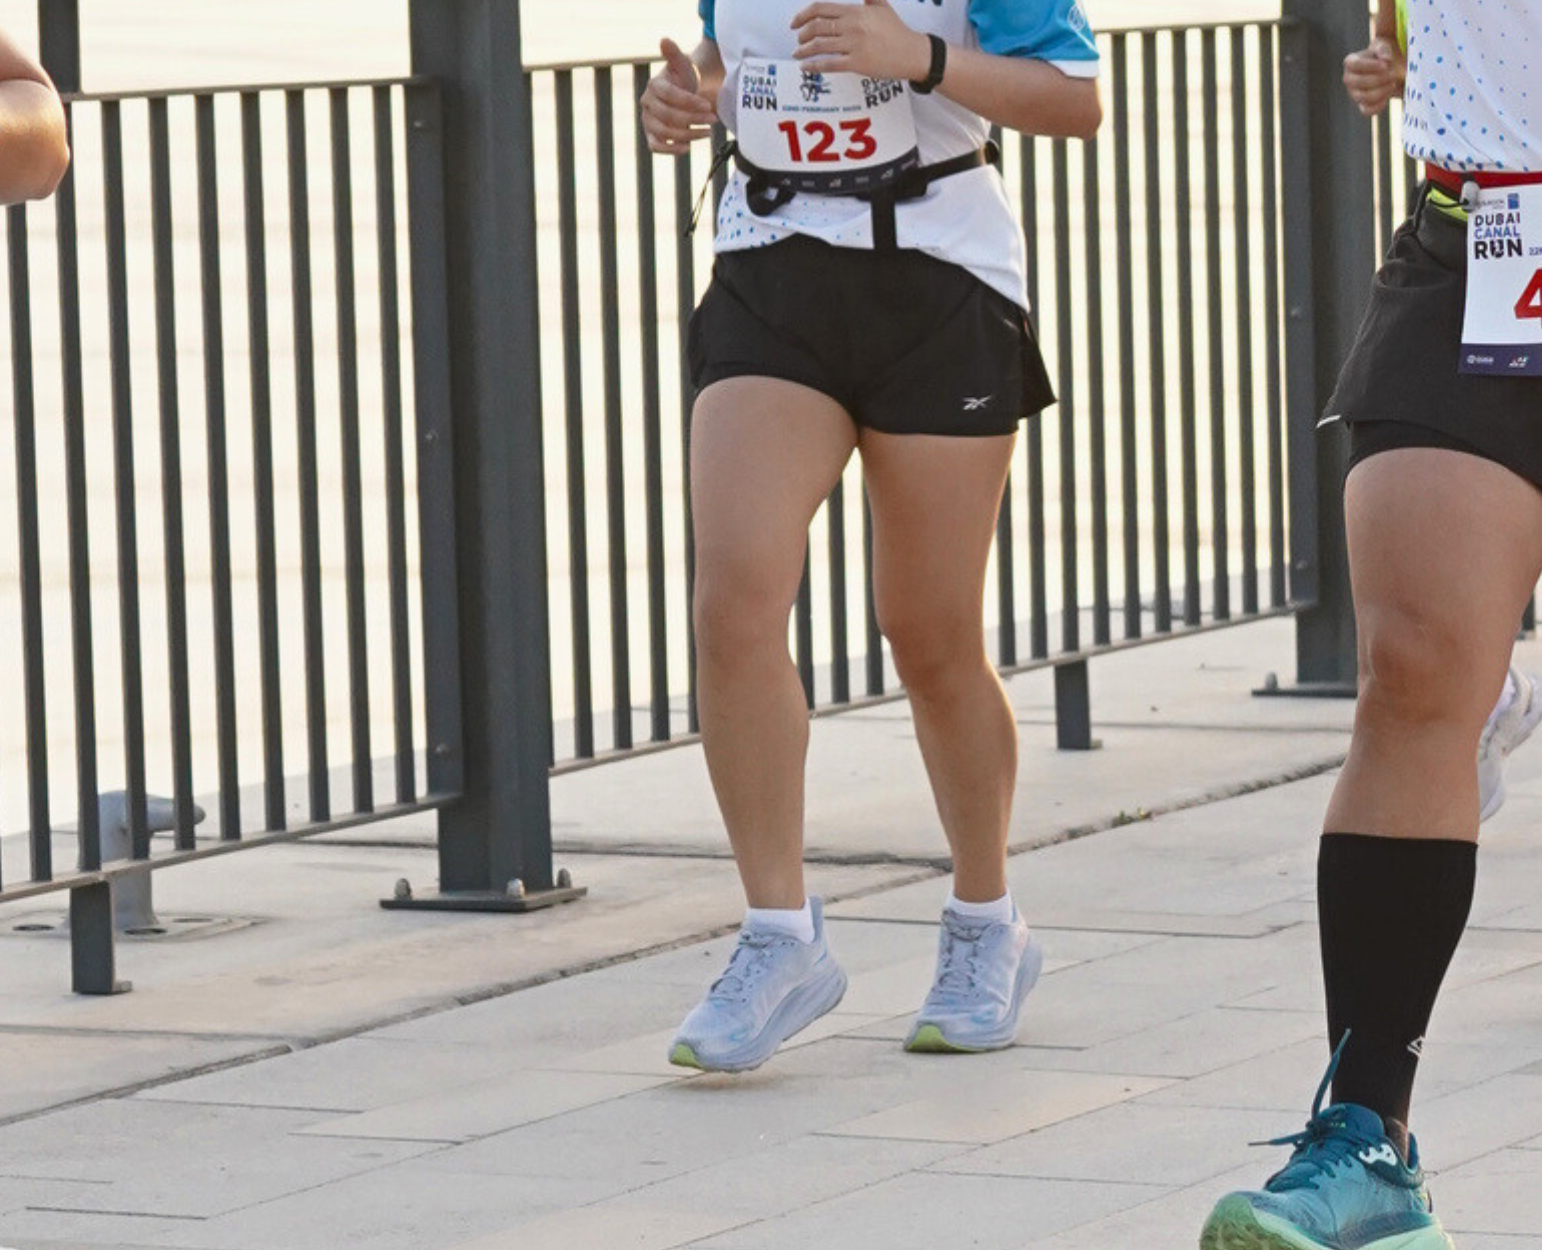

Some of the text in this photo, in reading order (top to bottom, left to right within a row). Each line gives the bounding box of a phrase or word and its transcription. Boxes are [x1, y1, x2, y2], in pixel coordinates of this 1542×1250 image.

[742, 95, 777, 111] RUN
[865, 80, 903, 109] RUN
[778, 117, 877, 163] 123
[1474, 213, 1520, 227] DUBAI
[1474, 226, 1520, 239] CANAL
[1474, 239, 1522, 259] RUN
